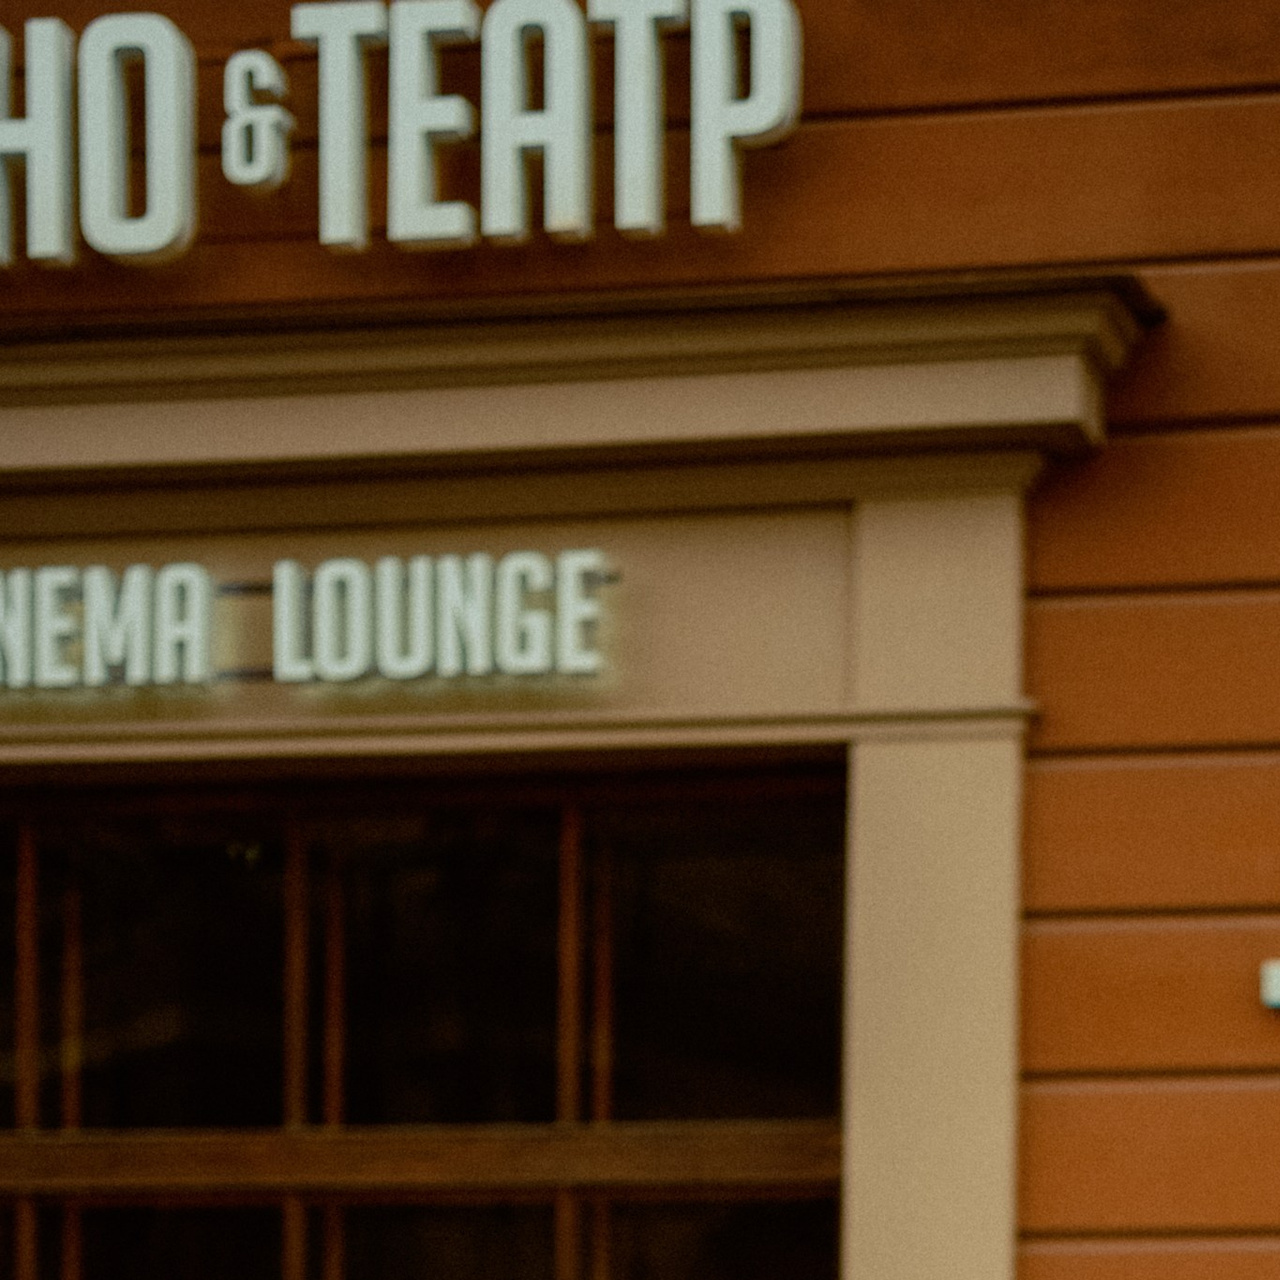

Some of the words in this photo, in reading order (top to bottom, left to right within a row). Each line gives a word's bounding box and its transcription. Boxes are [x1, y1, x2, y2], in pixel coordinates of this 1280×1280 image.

[221, 49, 295, 188] &
[290, 0, 800, 252] ТЕАТР
[271, 549, 607, 684] LOUNGE
